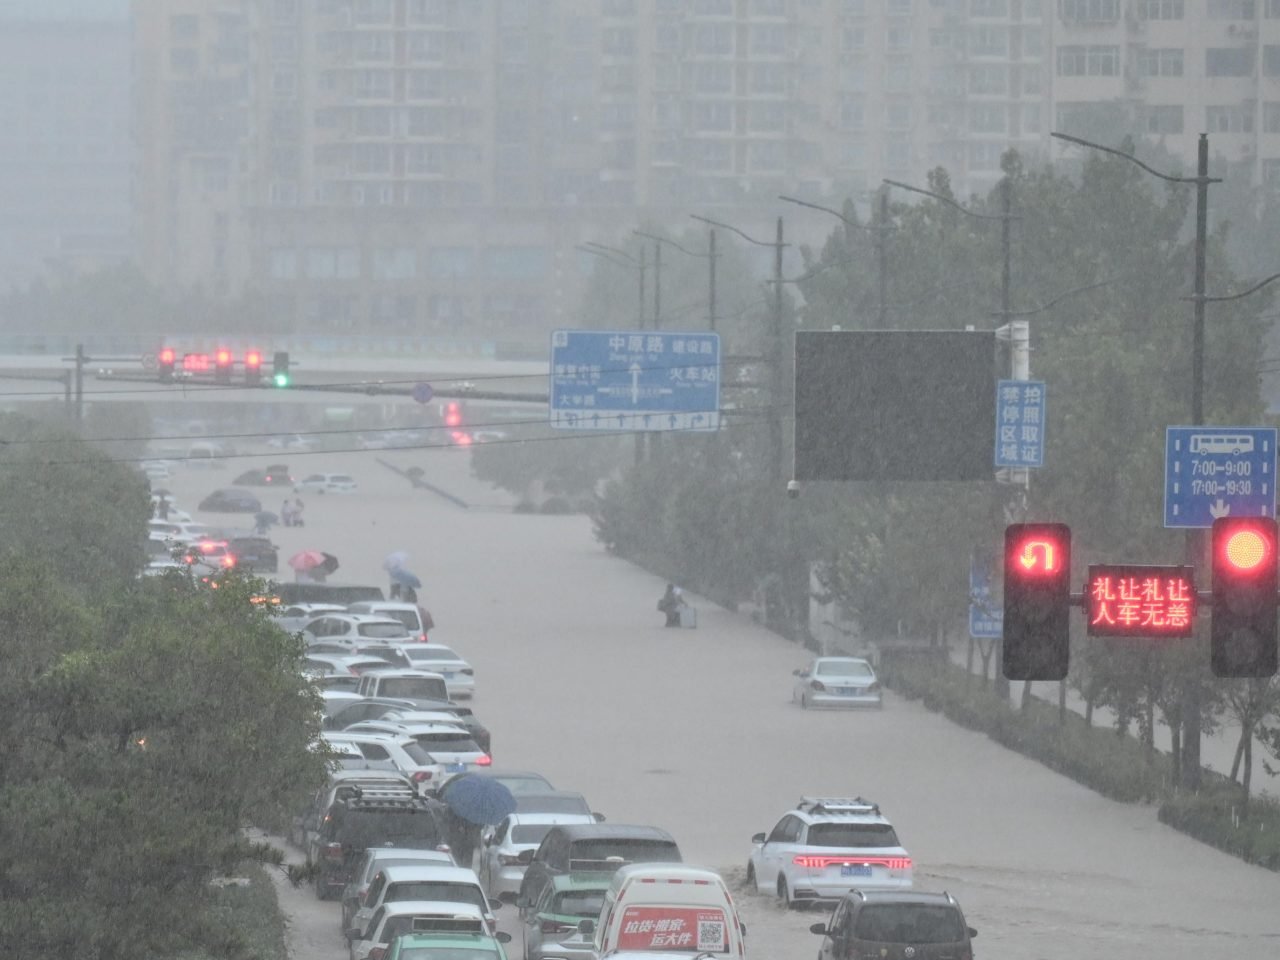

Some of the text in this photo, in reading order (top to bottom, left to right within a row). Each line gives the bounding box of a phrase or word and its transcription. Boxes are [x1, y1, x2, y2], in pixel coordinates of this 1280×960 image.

[609, 336, 663, 352] 中原路
[670, 367, 716, 382] 火车站
[1021, 386, 1040, 462] 拍照取证
[1092, 578, 1190, 601] 礼让礼让
[1092, 602, 1189, 626] 人车无恙
[650, 933, 692, 946] 运大件
